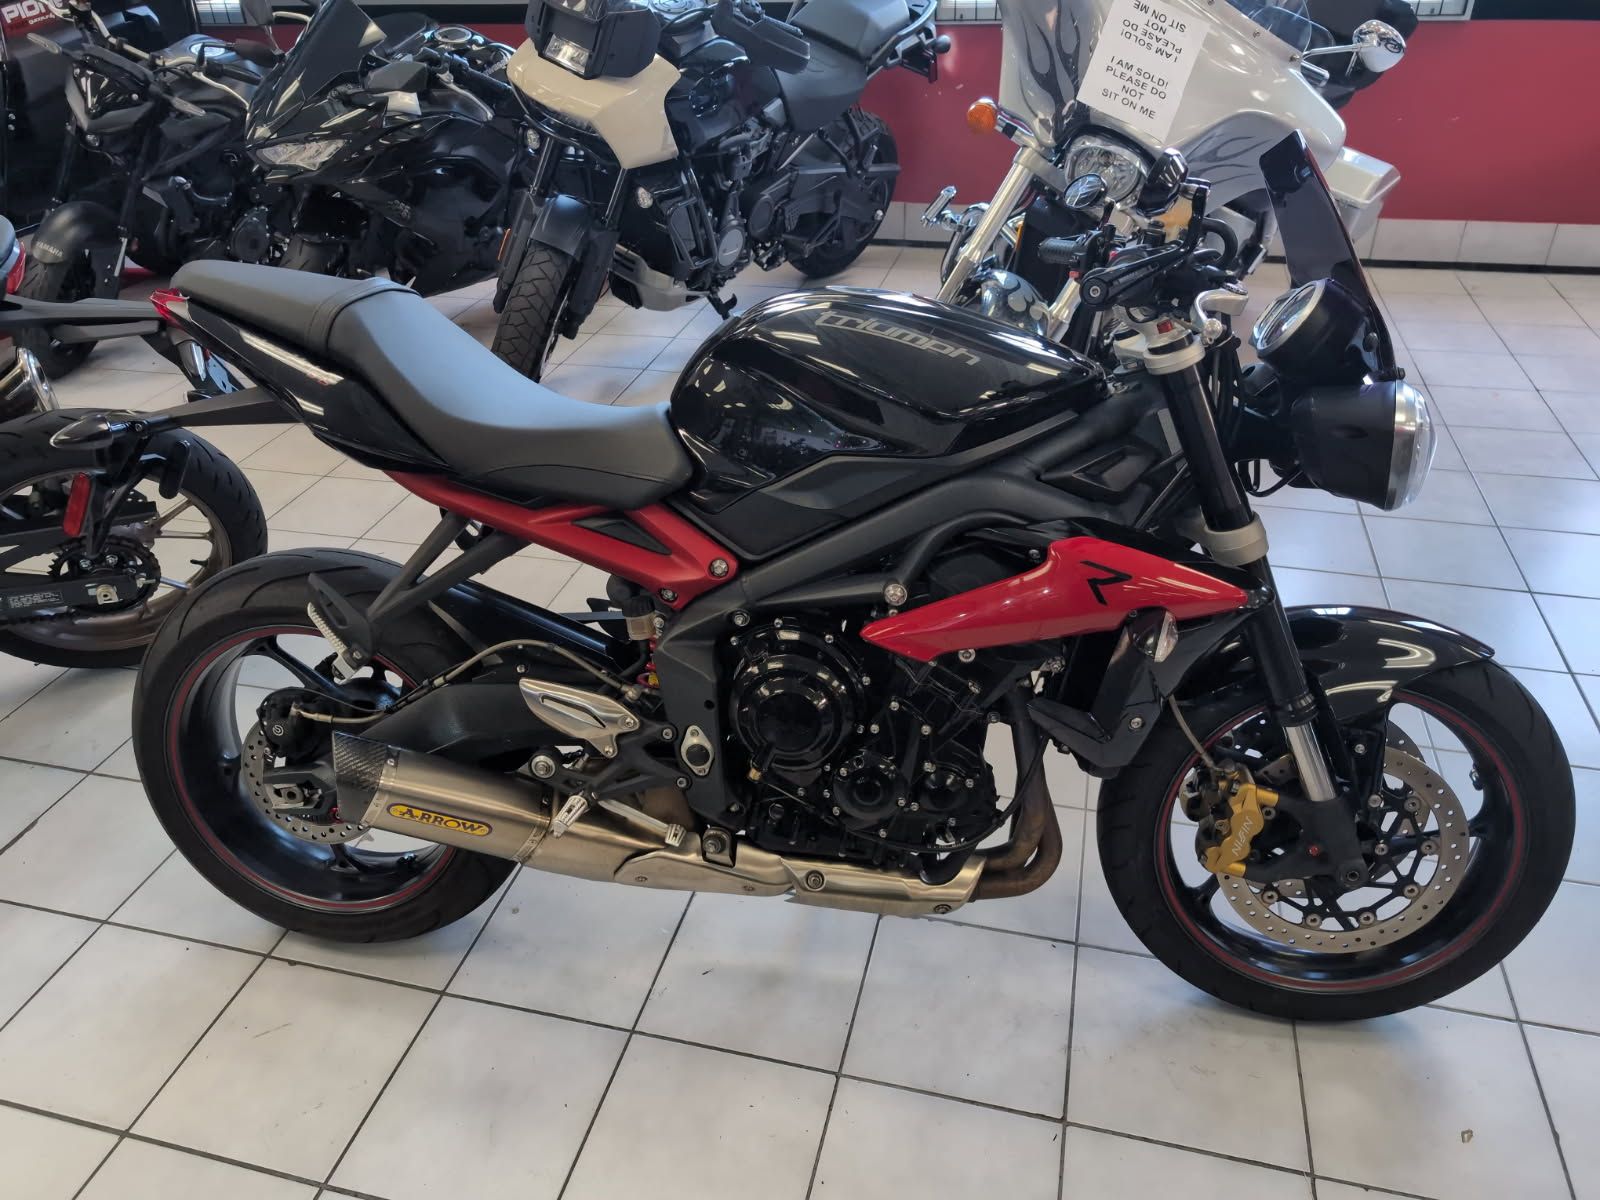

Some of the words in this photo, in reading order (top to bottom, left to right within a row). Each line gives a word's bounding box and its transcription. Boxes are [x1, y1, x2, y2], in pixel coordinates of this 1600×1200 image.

[1133, 0, 1150, 14] ME
[1151, 9, 1167, 24] ON
[1122, 19, 1139, 32] DO
[1144, 19, 1167, 35] NOT
[1168, 19, 1187, 33] SIT
[1120, 29, 1153, 51] SOLD!
[1141, 28, 1183, 55] PLEASE
[1155, 47, 1173, 59] AM
[1116, 59, 1134, 72] AM
[1135, 67, 1169, 89] SOLD!
[1105, 65, 1148, 91] PLEASE
[1150, 86, 1167, 100] DO
[1121, 85, 1145, 101] NOT
[1101, 88, 1120, 101] SIT
[1121, 97, 1138, 111] ON
[1139, 105, 1157, 119] ME
[399, 808, 483, 832] ARROW
